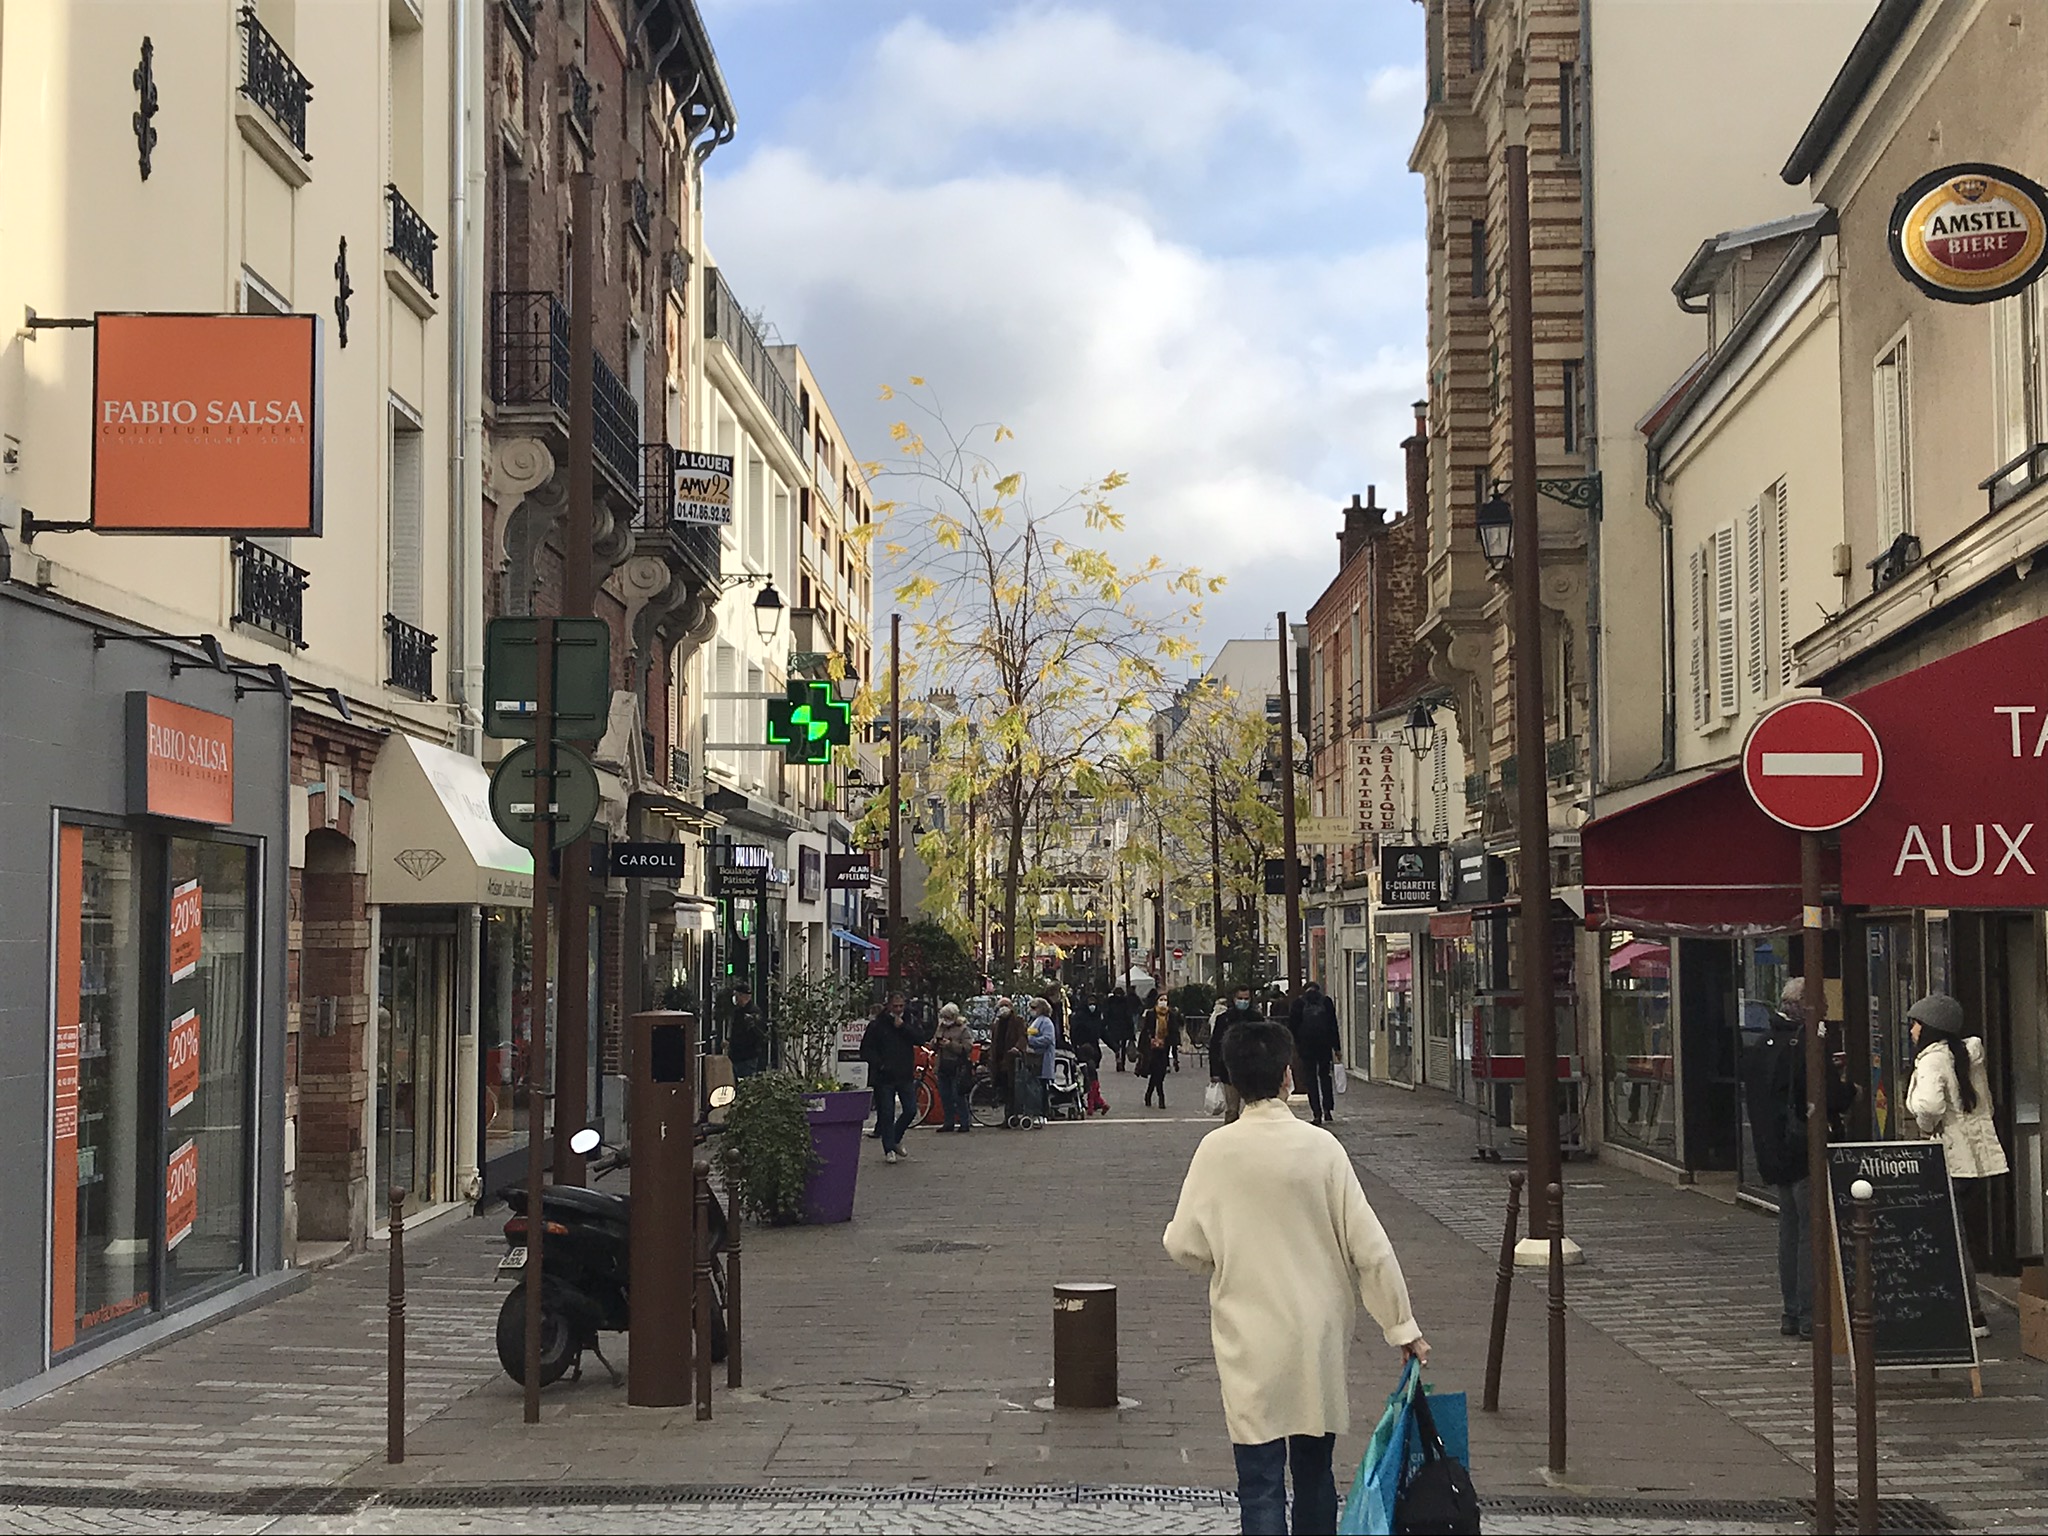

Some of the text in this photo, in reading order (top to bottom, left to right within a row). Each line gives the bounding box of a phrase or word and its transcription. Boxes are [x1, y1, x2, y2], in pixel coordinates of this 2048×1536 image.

[1931, 210, 2021, 236] AMSTEL
[1948, 235, 2009, 254] BIERE
[103, 400, 305, 425] FABIO SALSA
[228, 426, 305, 435] EXPERT
[679, 452, 730, 472] A LOUER
[149, 723, 228, 772] FABIO SALSA
[1358, 745, 1374, 831] TRAITEUR
[1380, 745, 1395, 830] ASIATIQUE
[619, 854, 676, 866] CAROLL
[1893, 823, 2037, 877] AUX
[719, 866, 760, 876] Boulanger
[1385, 880, 1437, 890] E-CIGARETTE
[1391, 890, 1431, 900] E-LIQUIDE
[170, 894, 200, 937] -20%
[168, 1023, 198, 1070] -20%
[166, 1153, 196, 1204] -20%
[1857, 1157, 1920, 1178] Affligem
